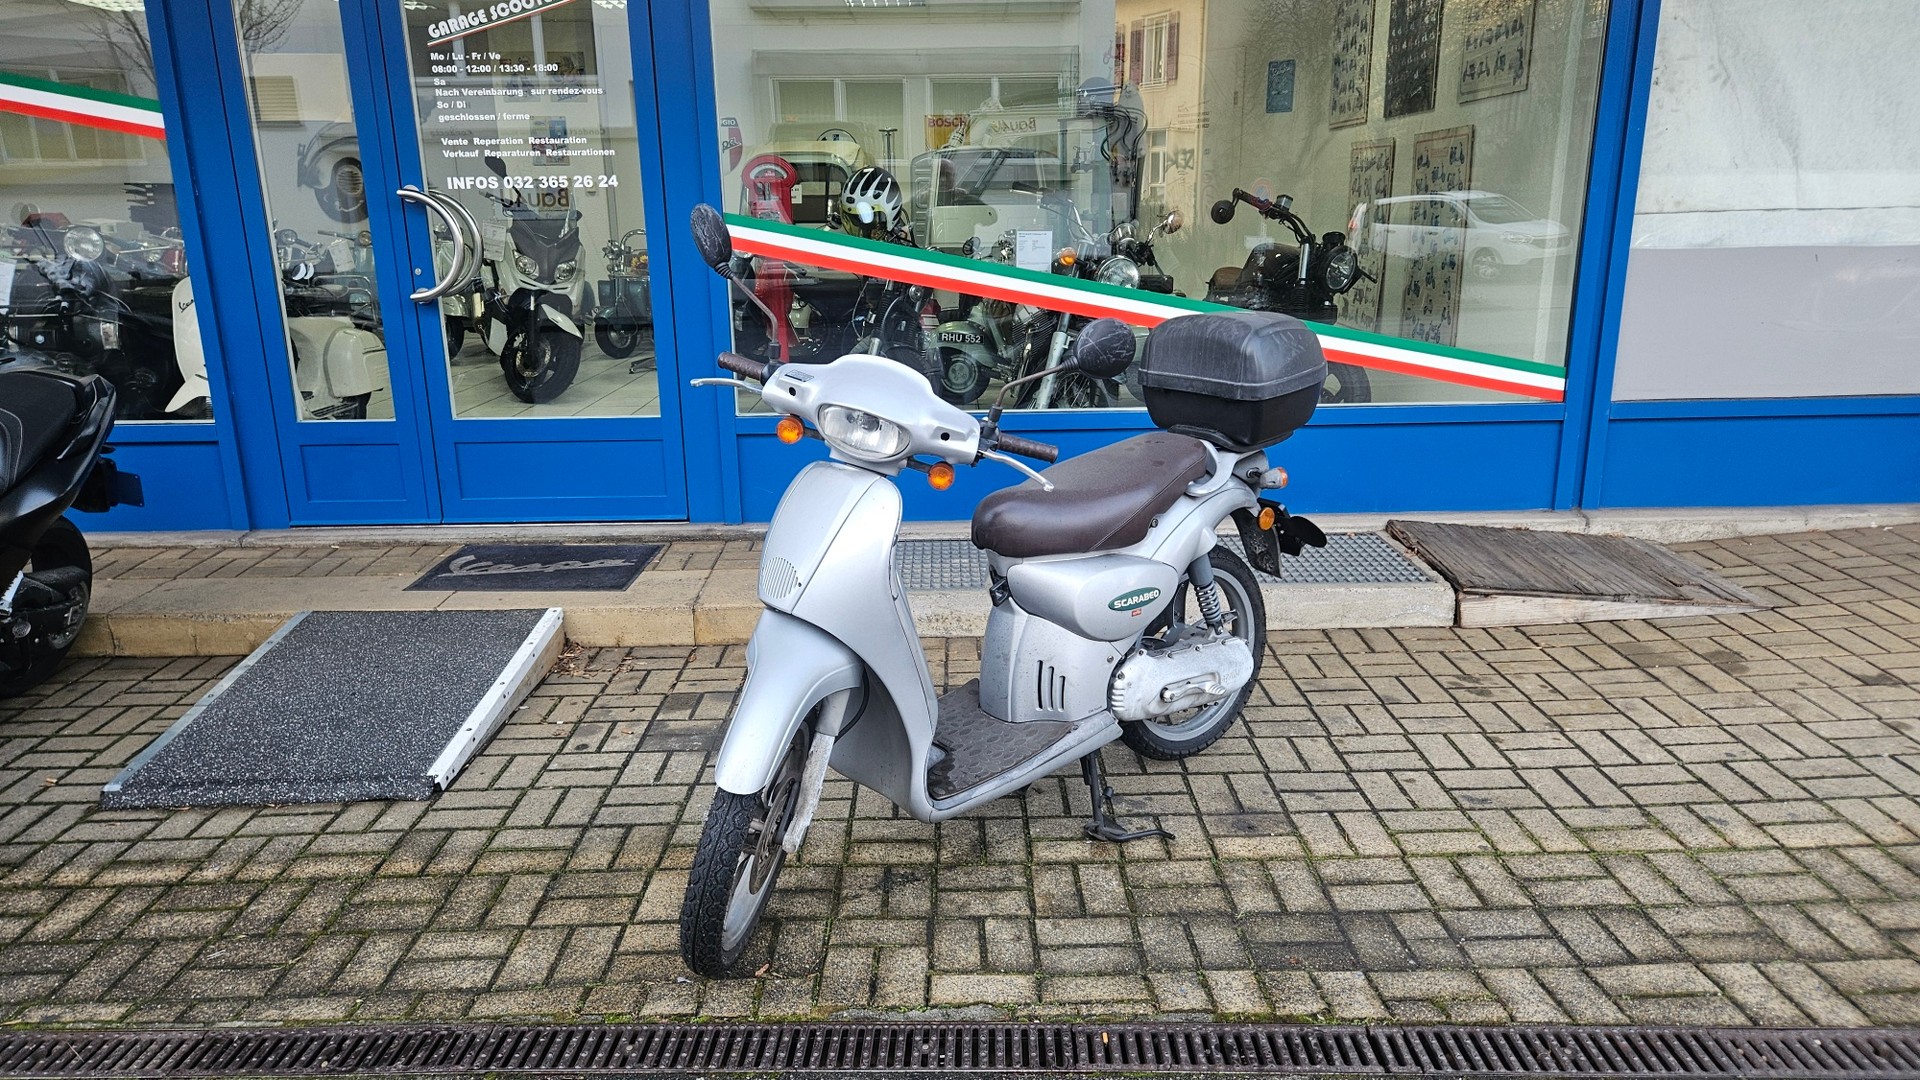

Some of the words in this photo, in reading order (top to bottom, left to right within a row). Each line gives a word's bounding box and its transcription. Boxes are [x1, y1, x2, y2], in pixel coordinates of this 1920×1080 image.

[428, 9, 488, 38] GARAGE
[461, 88, 524, 97] Vereinbarung
[438, 113, 496, 122] geschlossen
[528, 137, 587, 145] Restauration
[484, 149, 541, 158] Reparaturen
[447, 177, 498, 190] INFOS
[503, 176, 534, 189] 032
[539, 176, 568, 188] 365
[574, 175, 593, 188] 26
[598, 175, 618, 187] 24
[942, 333, 963, 344] RHU
[965, 334, 981, 344] 552
[438, 555, 638, 578] Vespa
[1114, 590, 1160, 608] SCARABEO
